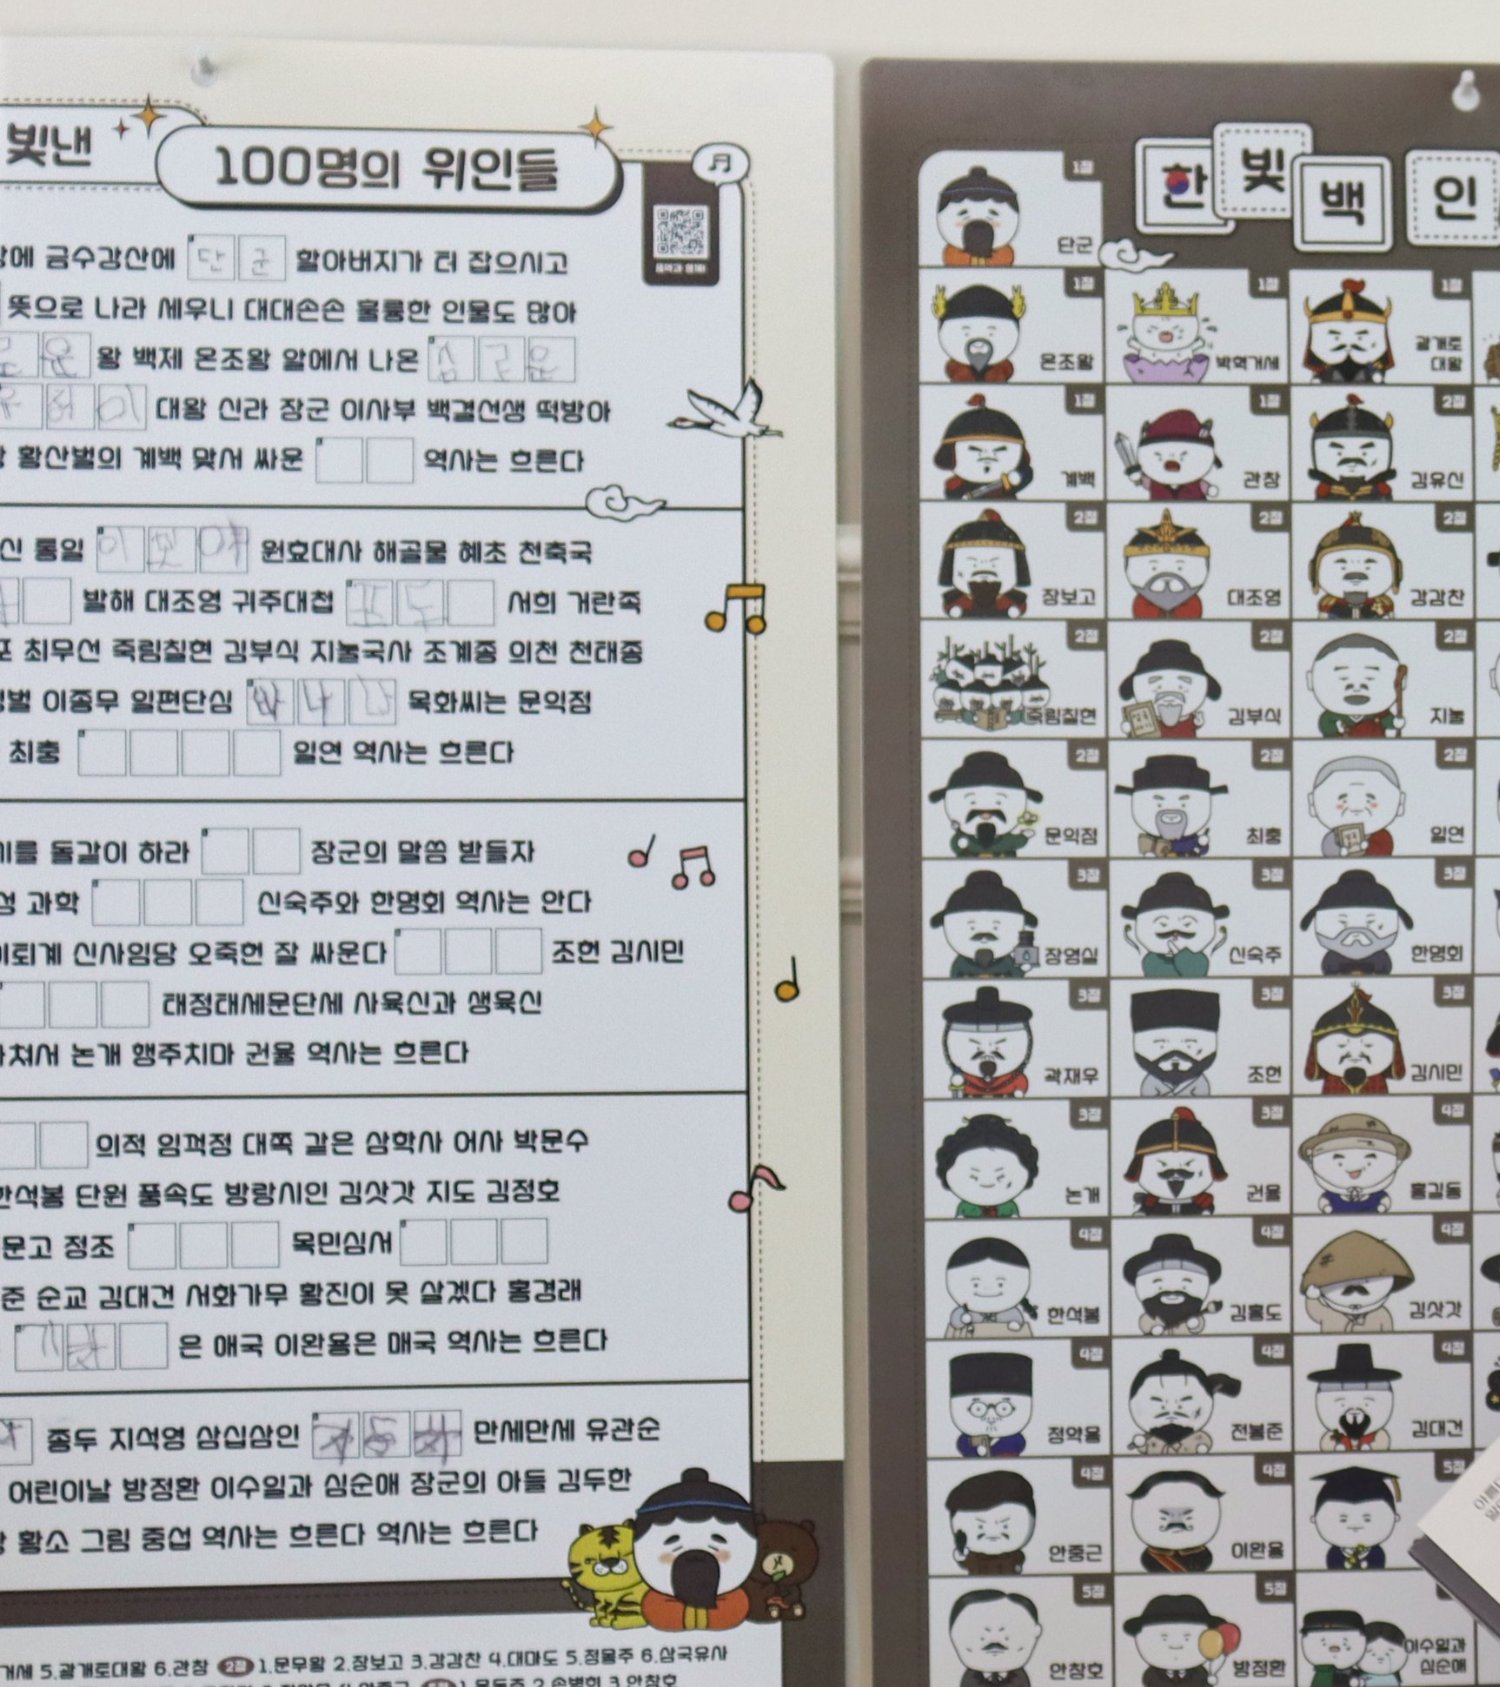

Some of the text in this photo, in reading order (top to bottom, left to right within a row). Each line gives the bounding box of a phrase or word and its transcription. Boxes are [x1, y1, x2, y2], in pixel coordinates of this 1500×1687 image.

[5, 121, 93, 169] 빛낸
[214, 144, 560, 193] 100명의 위인들
[1057, 236, 1093, 255] 단군
[46, 245, 176, 272] 금수강산에
[296, 248, 568, 276] 할아버지가 터 잡으시고
[8, 294, 577, 325] 뜻으로 나라 세우니 대대손손 훌륭한 인물도 많아
[1040, 352, 1095, 372] 온조왕
[155, 396, 208, 422] 대왕
[218, 396, 269, 422] 신라
[280, 397, 330, 423] 장군
[340, 398, 416, 422] 이사부
[426, 398, 526, 424] 백결선생
[535, 399, 612, 424] 떡방아
[17, 444, 585, 474] 황산벌의 계백 맞서 싸운 역사는 흐른다
[1061, 470, 1096, 489] 계백
[1243, 470, 1281, 490] 관창
[1411, 471, 1465, 490] 김유신
[34, 537, 84, 563] 통일
[261, 539, 363, 564] 원효대사
[373, 539, 448, 565] 해골물
[458, 540, 507, 565] 혜초
[519, 540, 593, 566] 천축국
[82, 588, 135, 614] 발해
[144, 589, 222, 614] 대조영
[232, 589, 334, 615] 귀주대첩
[507, 590, 557, 615] 서희
[567, 590, 642, 616] 거란족
[1042, 587, 1096, 607] 장보고
[1227, 588, 1282, 607] 대조영
[1410, 588, 1466, 607] 강감찬
[24, 637, 643, 665] 최무선 죽림칠현 김부식 지눌국사 조계종 의천 천태종
[1228, 707, 1282, 726] 김부식
[1430, 707, 1465, 726] 지눌
[1044, 826, 1098, 846] 문익점
[1246, 826, 1282, 846] 최충
[1430, 825, 1465, 844] 일연
[73, 937, 685, 967] 신사임당 오죽헌 잘 싸운다 조헌 김시민
[1045, 946, 1099, 966] 장영실
[1229, 945, 1282, 965] 신숙주
[1411, 944, 1464, 964] 한명회
[162, 989, 542, 1017] 태정태세문단세 사육신과 생육신
[1044, 1067, 1099, 1086] 곽재우
[1248, 1065, 1282, 1084] 조헌
[1411, 1063, 1463, 1083] 김시민
[75, 1178, 561, 1209] 단원 풍속도 방랑시인 김삿갓 지도 김정호
[1065, 1186, 1101, 1205] 논개
[1246, 1183, 1282, 1203] 권율
[1047, 1306, 1101, 1326] 한석봉
[1409, 1300, 1463, 1320] 김삿갓
[1048, 1425, 1102, 1445] 정약용
[1412, 1419, 1464, 1439] 김대건
[8, 1467, 633, 1505] 어린이날 방정환 이수일과 심순애 장군의 아들 김두한
[1048, 1543, 1103, 1563] 안중근
[1231, 1540, 1285, 1560] 이완용
[259, 1644, 728, 1675] 1.문무왕 2.장보고 3.강감찬 4.대마도 5.정몽주 6.삼국유사
[1232, 1658, 1287, 1678] 방정환
[1049, 1661, 1104, 1681] 안창호
